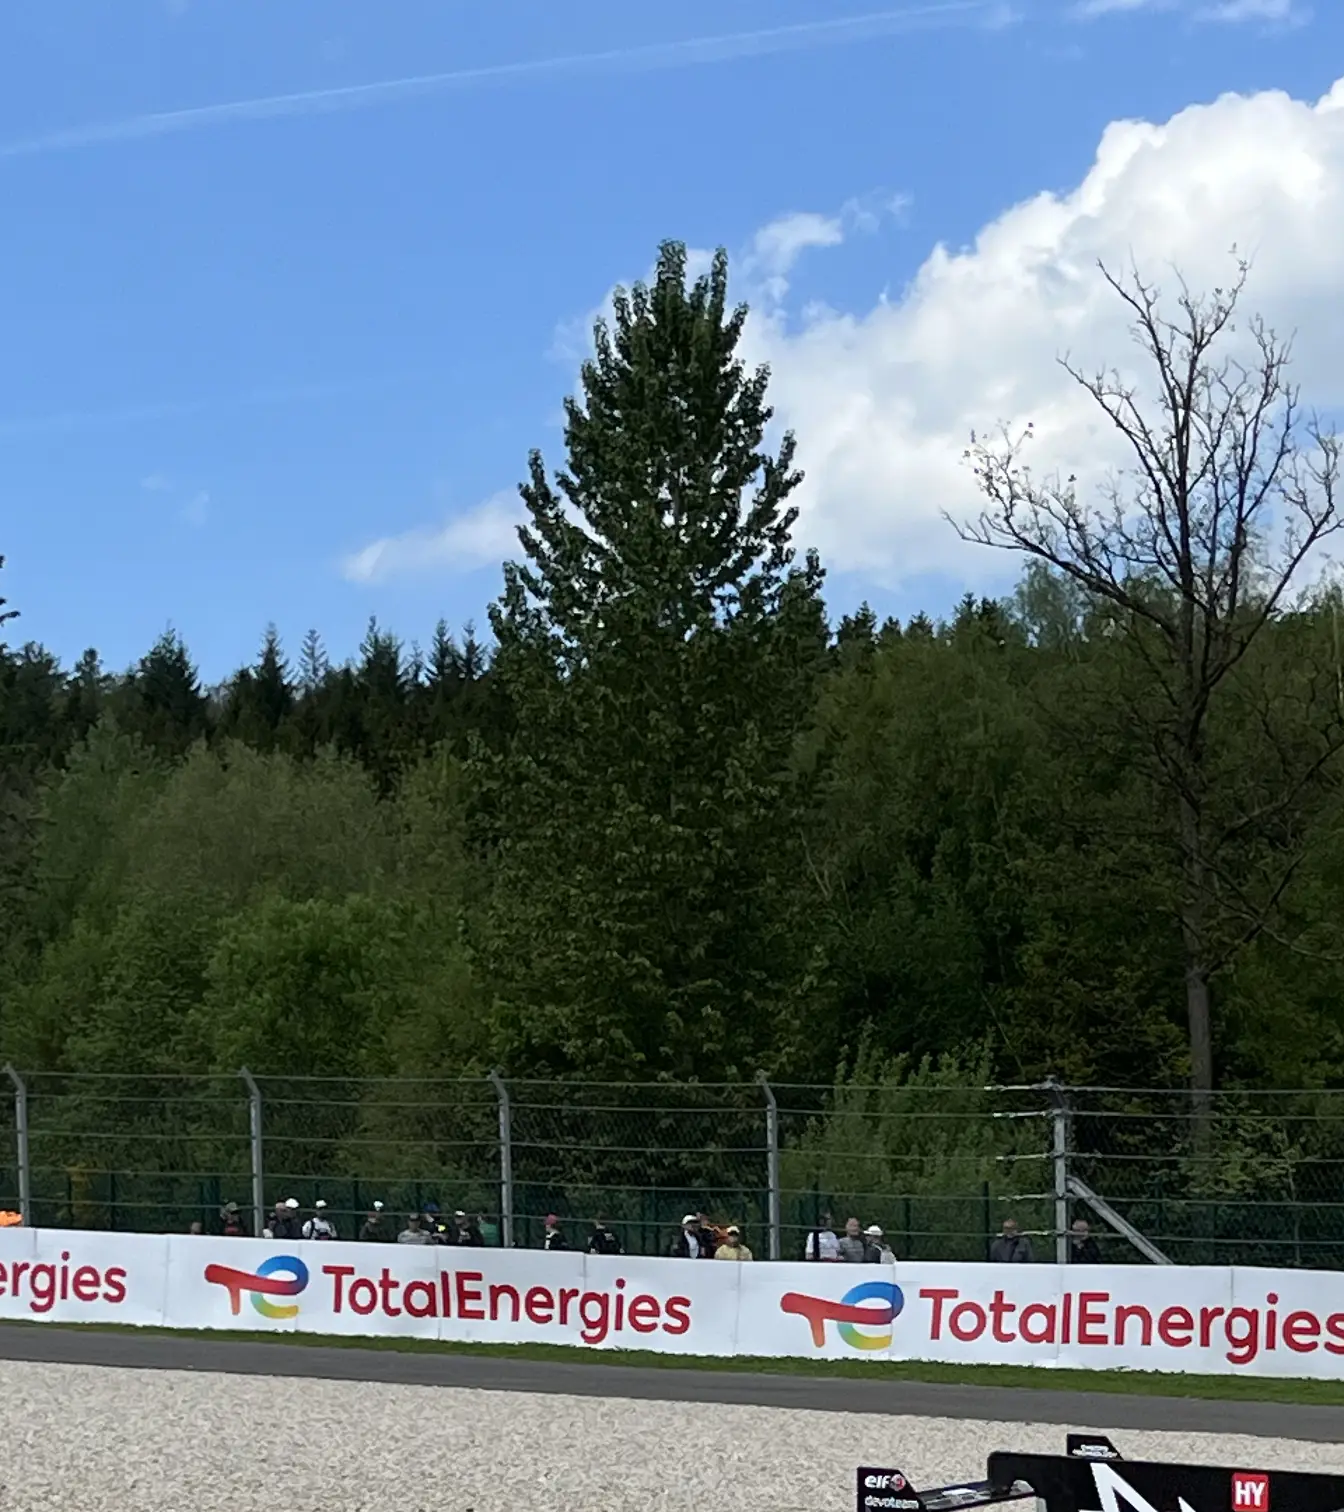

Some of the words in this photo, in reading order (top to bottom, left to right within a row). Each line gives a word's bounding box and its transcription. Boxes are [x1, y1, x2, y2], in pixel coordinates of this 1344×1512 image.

[323, 1265, 691, 1345] TotalEnergies
[864, 1475, 891, 1489] elf
[1235, 1480, 1266, 1507] HY
